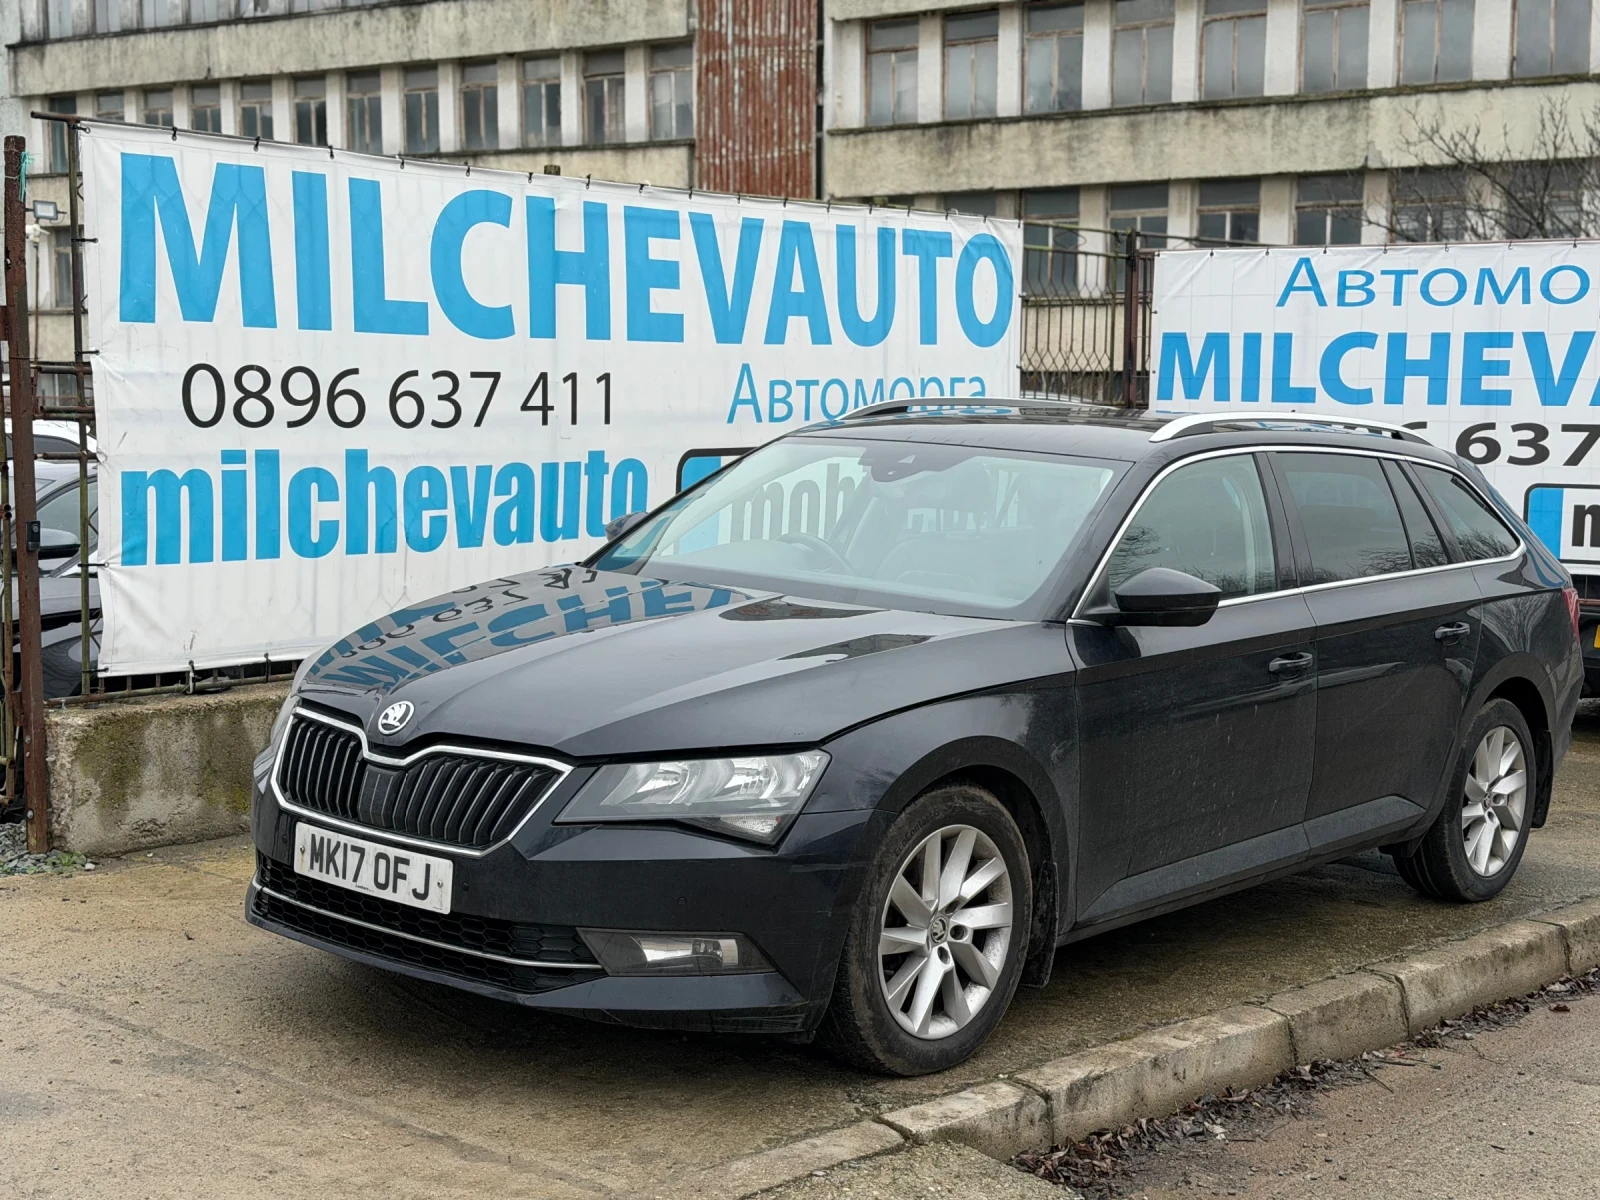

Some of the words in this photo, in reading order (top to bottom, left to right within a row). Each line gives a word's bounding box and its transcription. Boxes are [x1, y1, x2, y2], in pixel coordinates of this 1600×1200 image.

[119, 152, 1014, 348] MILCHEVAUTO
[1276, 256, 1600, 310] Автомо
[181, 363, 366, 429] 0896
[388, 369, 501, 429] 637
[520, 371, 611, 426] 411
[1455, 422, 1600, 467] 637
[120, 448, 648, 567] milchevauto
[309, 833, 366, 883] MK17
[373, 851, 431, 901] OFJ
